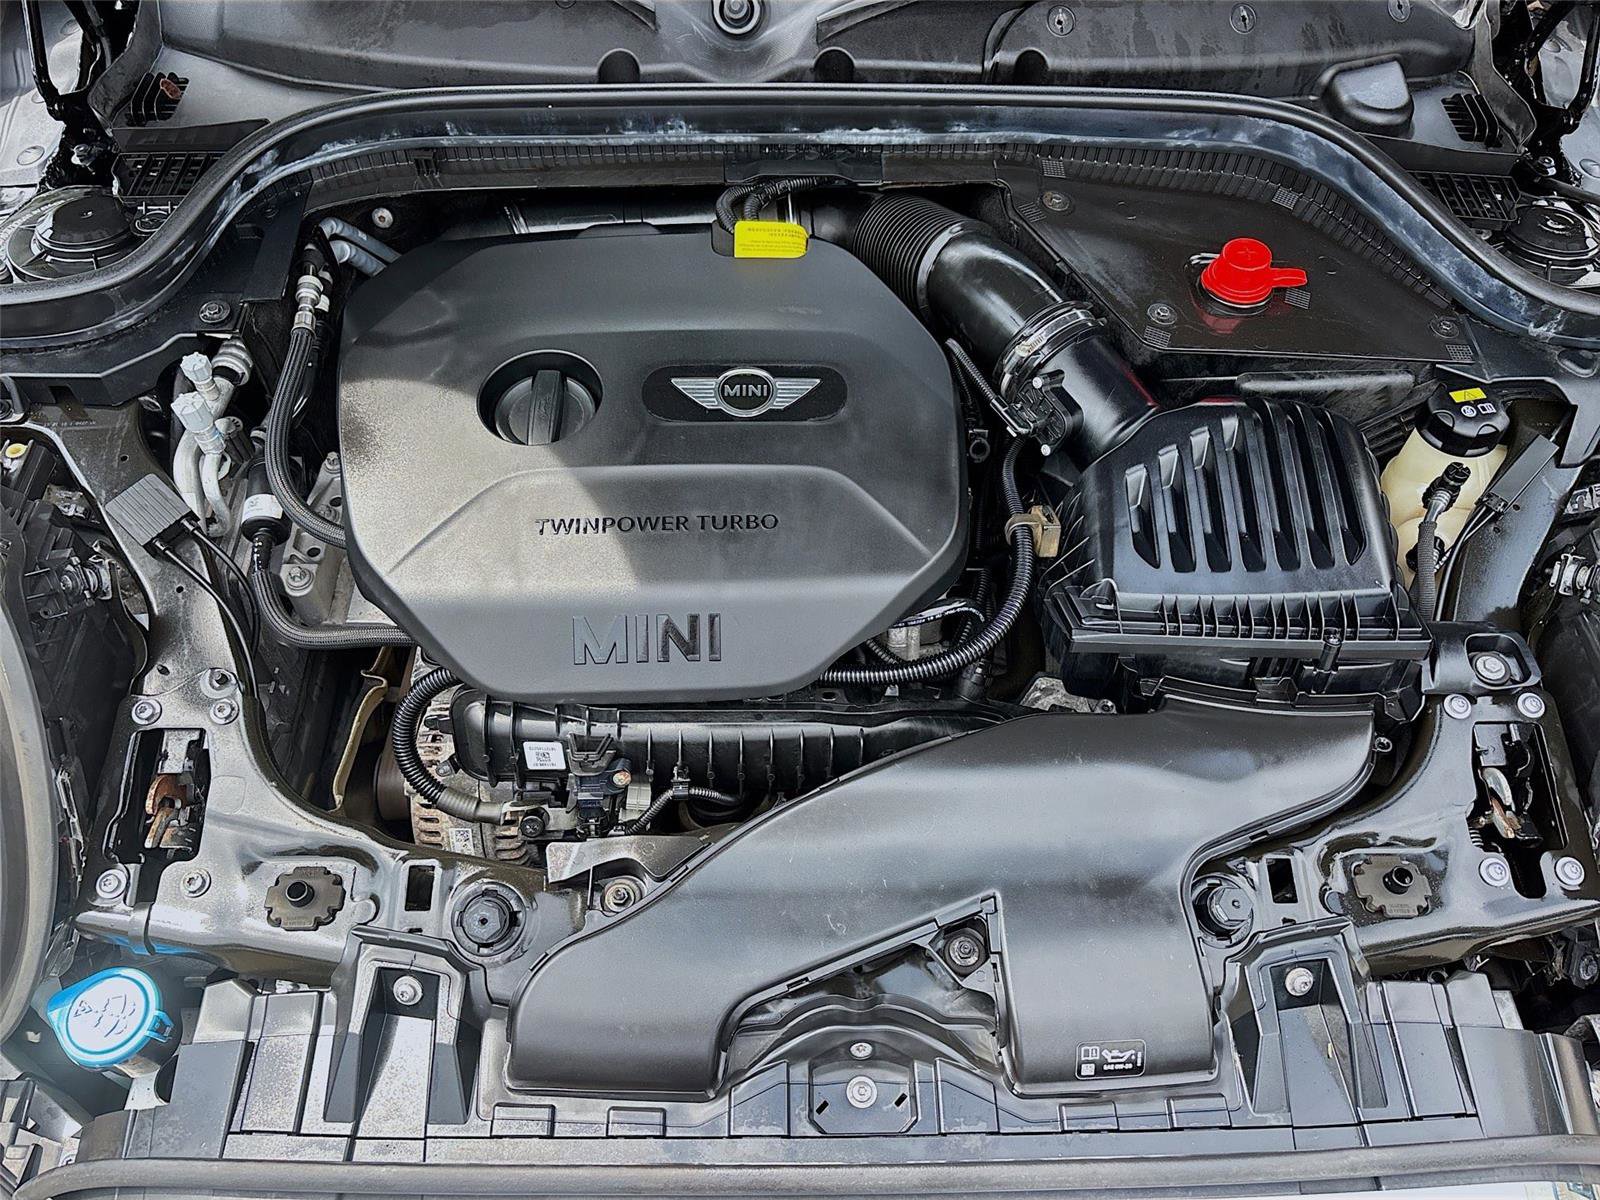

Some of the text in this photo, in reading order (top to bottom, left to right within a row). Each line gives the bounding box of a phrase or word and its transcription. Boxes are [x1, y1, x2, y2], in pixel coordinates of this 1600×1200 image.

[724, 385, 768, 397] MINI
[535, 514, 779, 535] TWINPOWER TURBO
[573, 613, 721, 665] MINI
